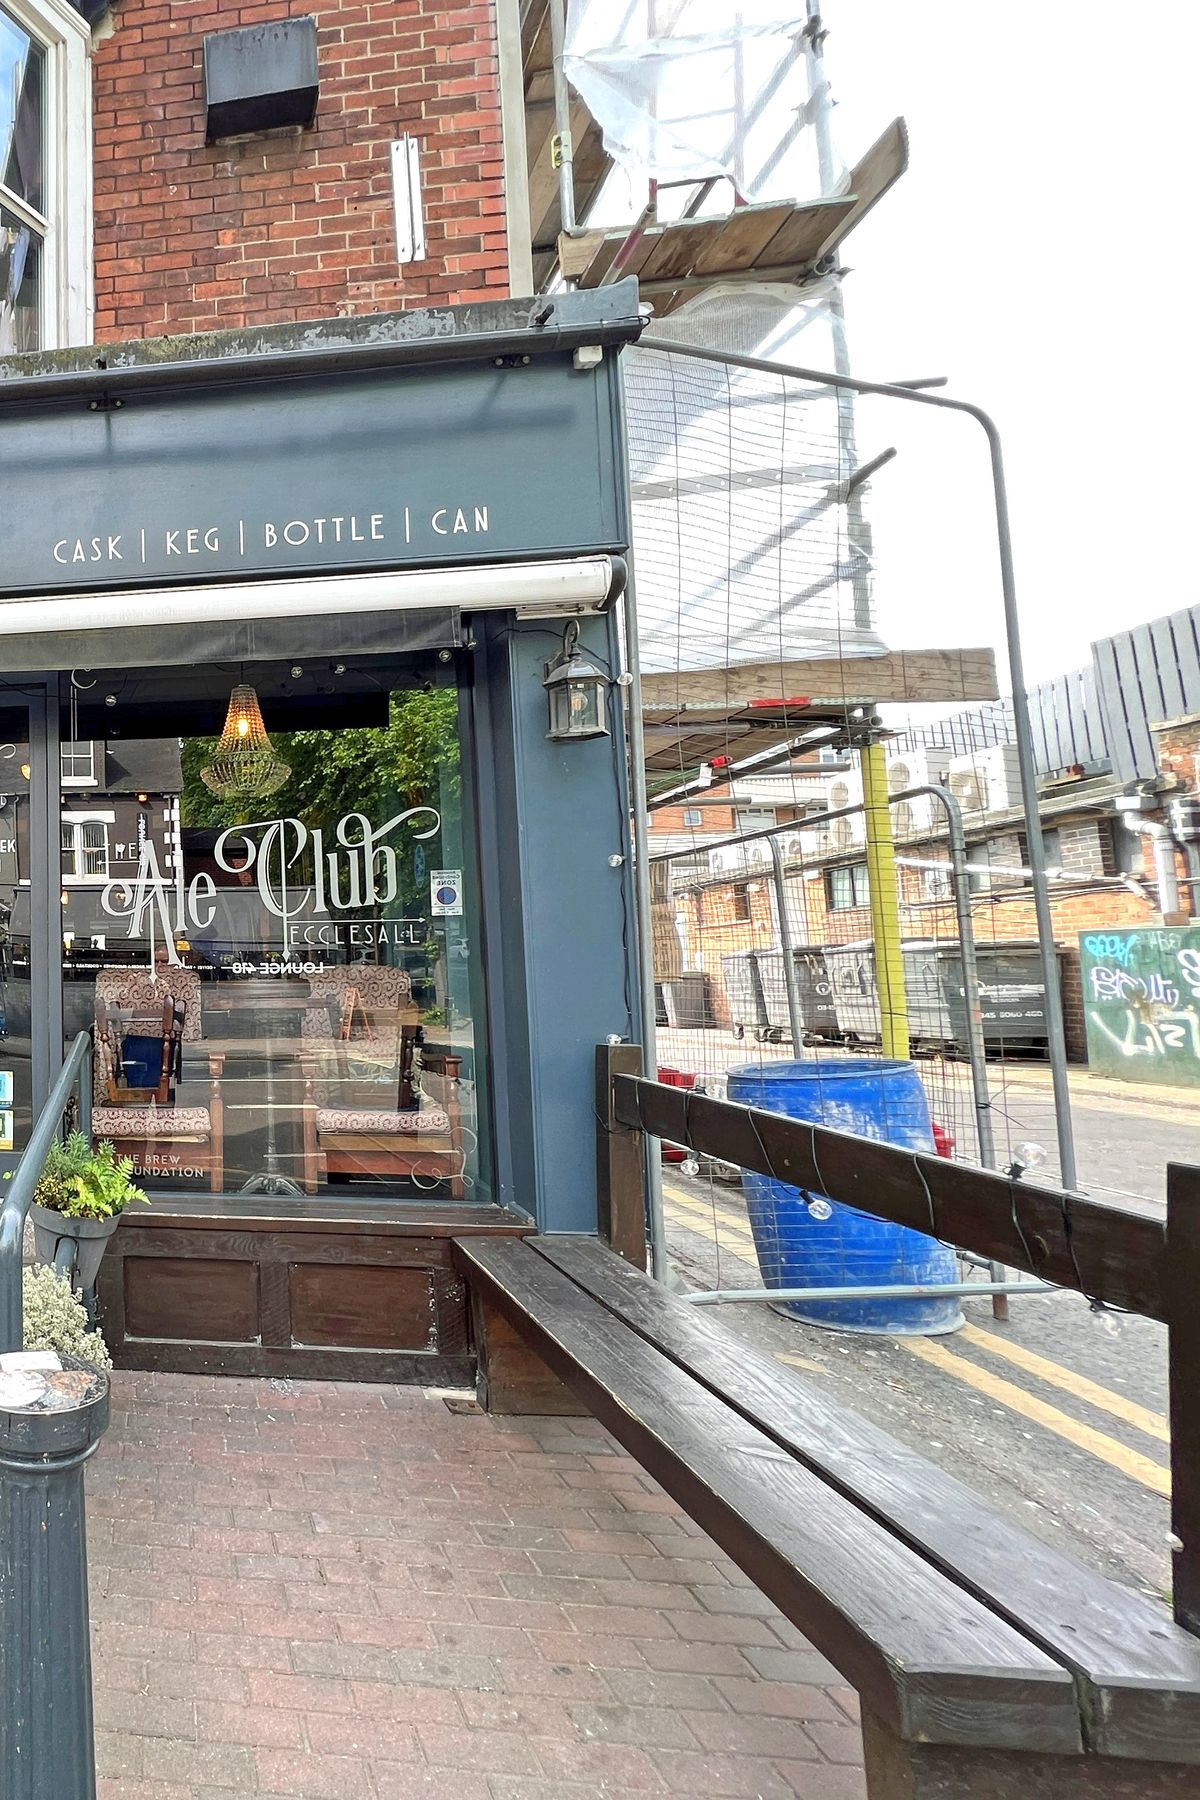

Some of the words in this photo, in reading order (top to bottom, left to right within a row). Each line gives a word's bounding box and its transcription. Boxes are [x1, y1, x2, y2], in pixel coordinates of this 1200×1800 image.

[53, 535, 124, 564] CASK
[165, 527, 220, 556] KEG
[265, 513, 385, 549] BOTTLE
[431, 506, 489, 536] CAN
[100, 839, 218, 984] Ale
[213, 806, 442, 963] Club
[290, 924, 421, 945] ECCLESALL
[145, 1154, 181, 1165] BREW
[133, 1165, 204, 1178] UNDATION
